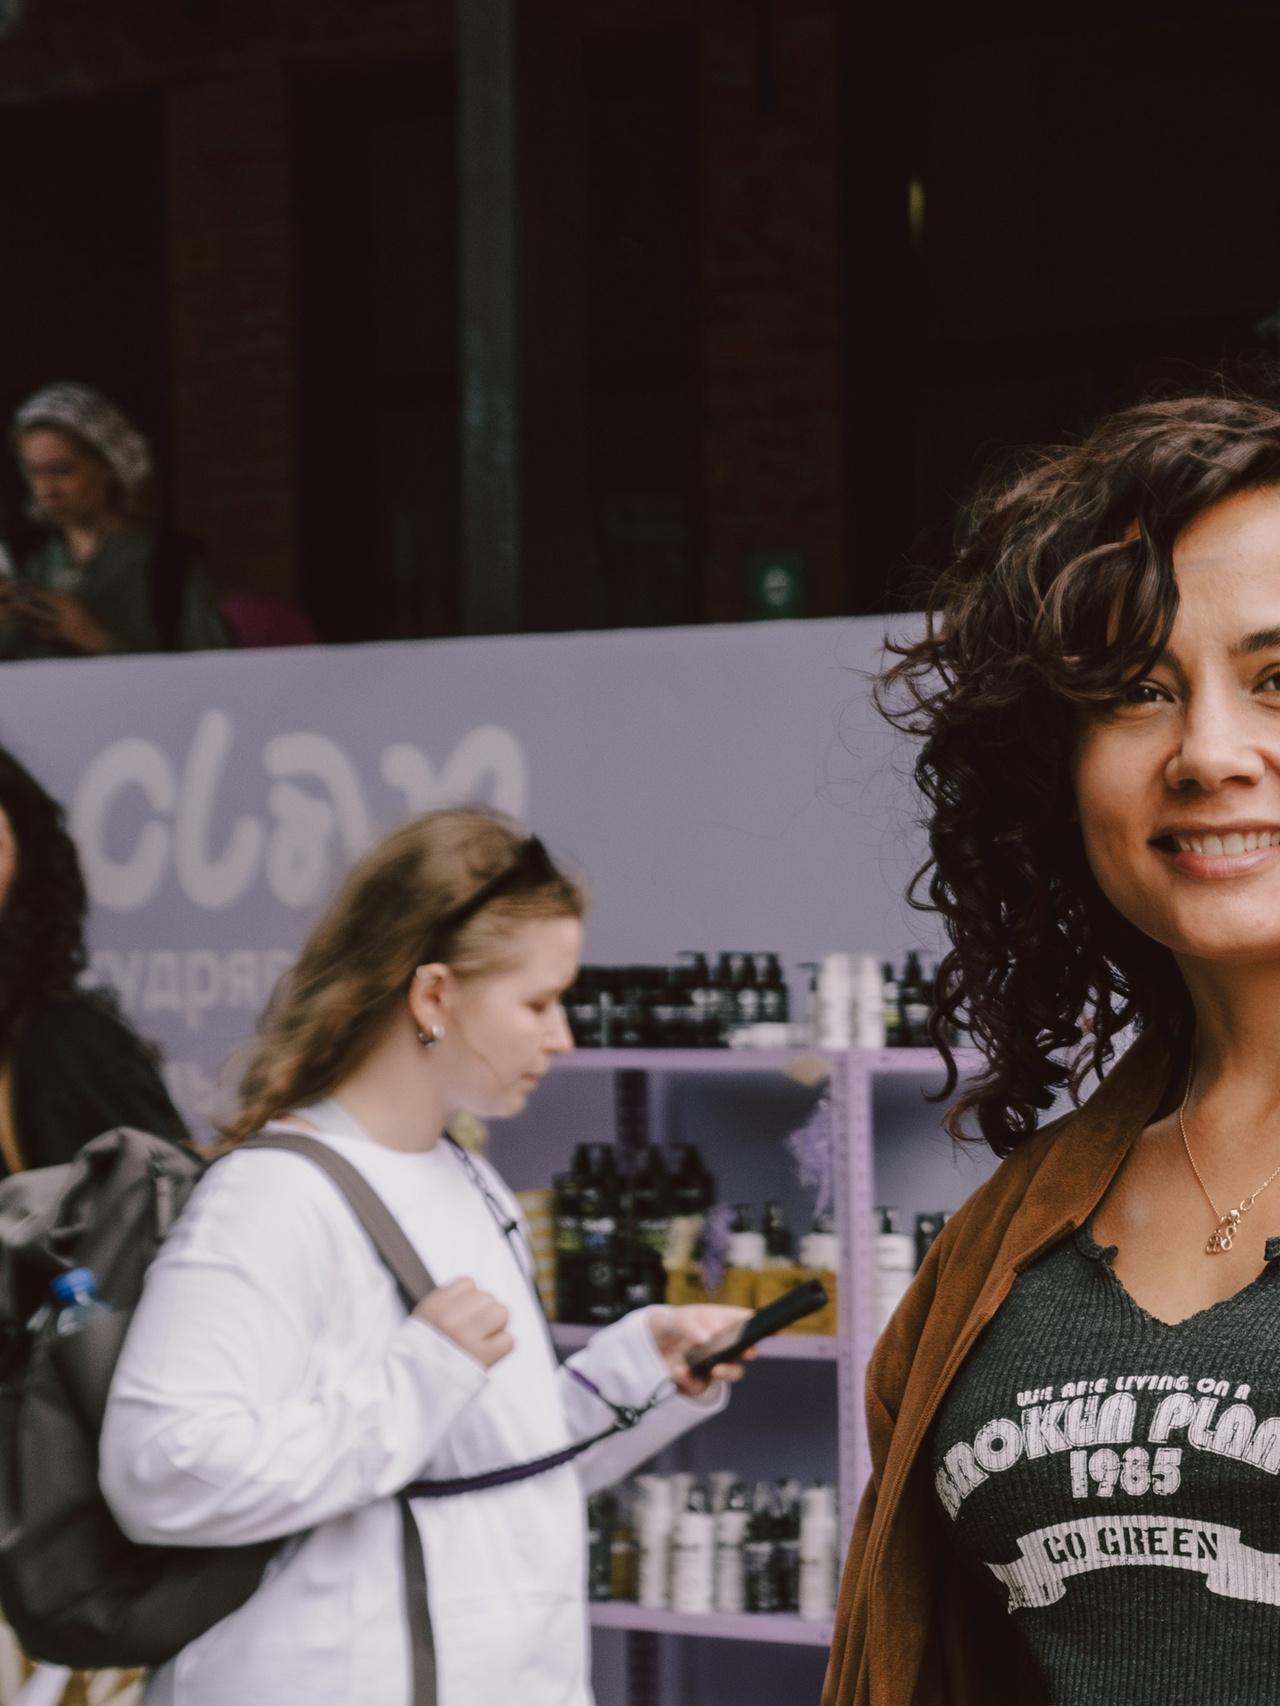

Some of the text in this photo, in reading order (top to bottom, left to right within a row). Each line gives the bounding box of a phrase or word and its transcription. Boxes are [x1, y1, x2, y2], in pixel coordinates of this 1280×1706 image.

[1061, 1378, 1108, 1398] ARE
[1115, 1375, 1189, 1391] LIVING
[1196, 1378, 1230, 1397] ON
[1233, 1384, 1251, 1400] A
[1069, 1446, 1182, 1498] 1985
[1043, 1526, 1218, 1564] GO GREEN
